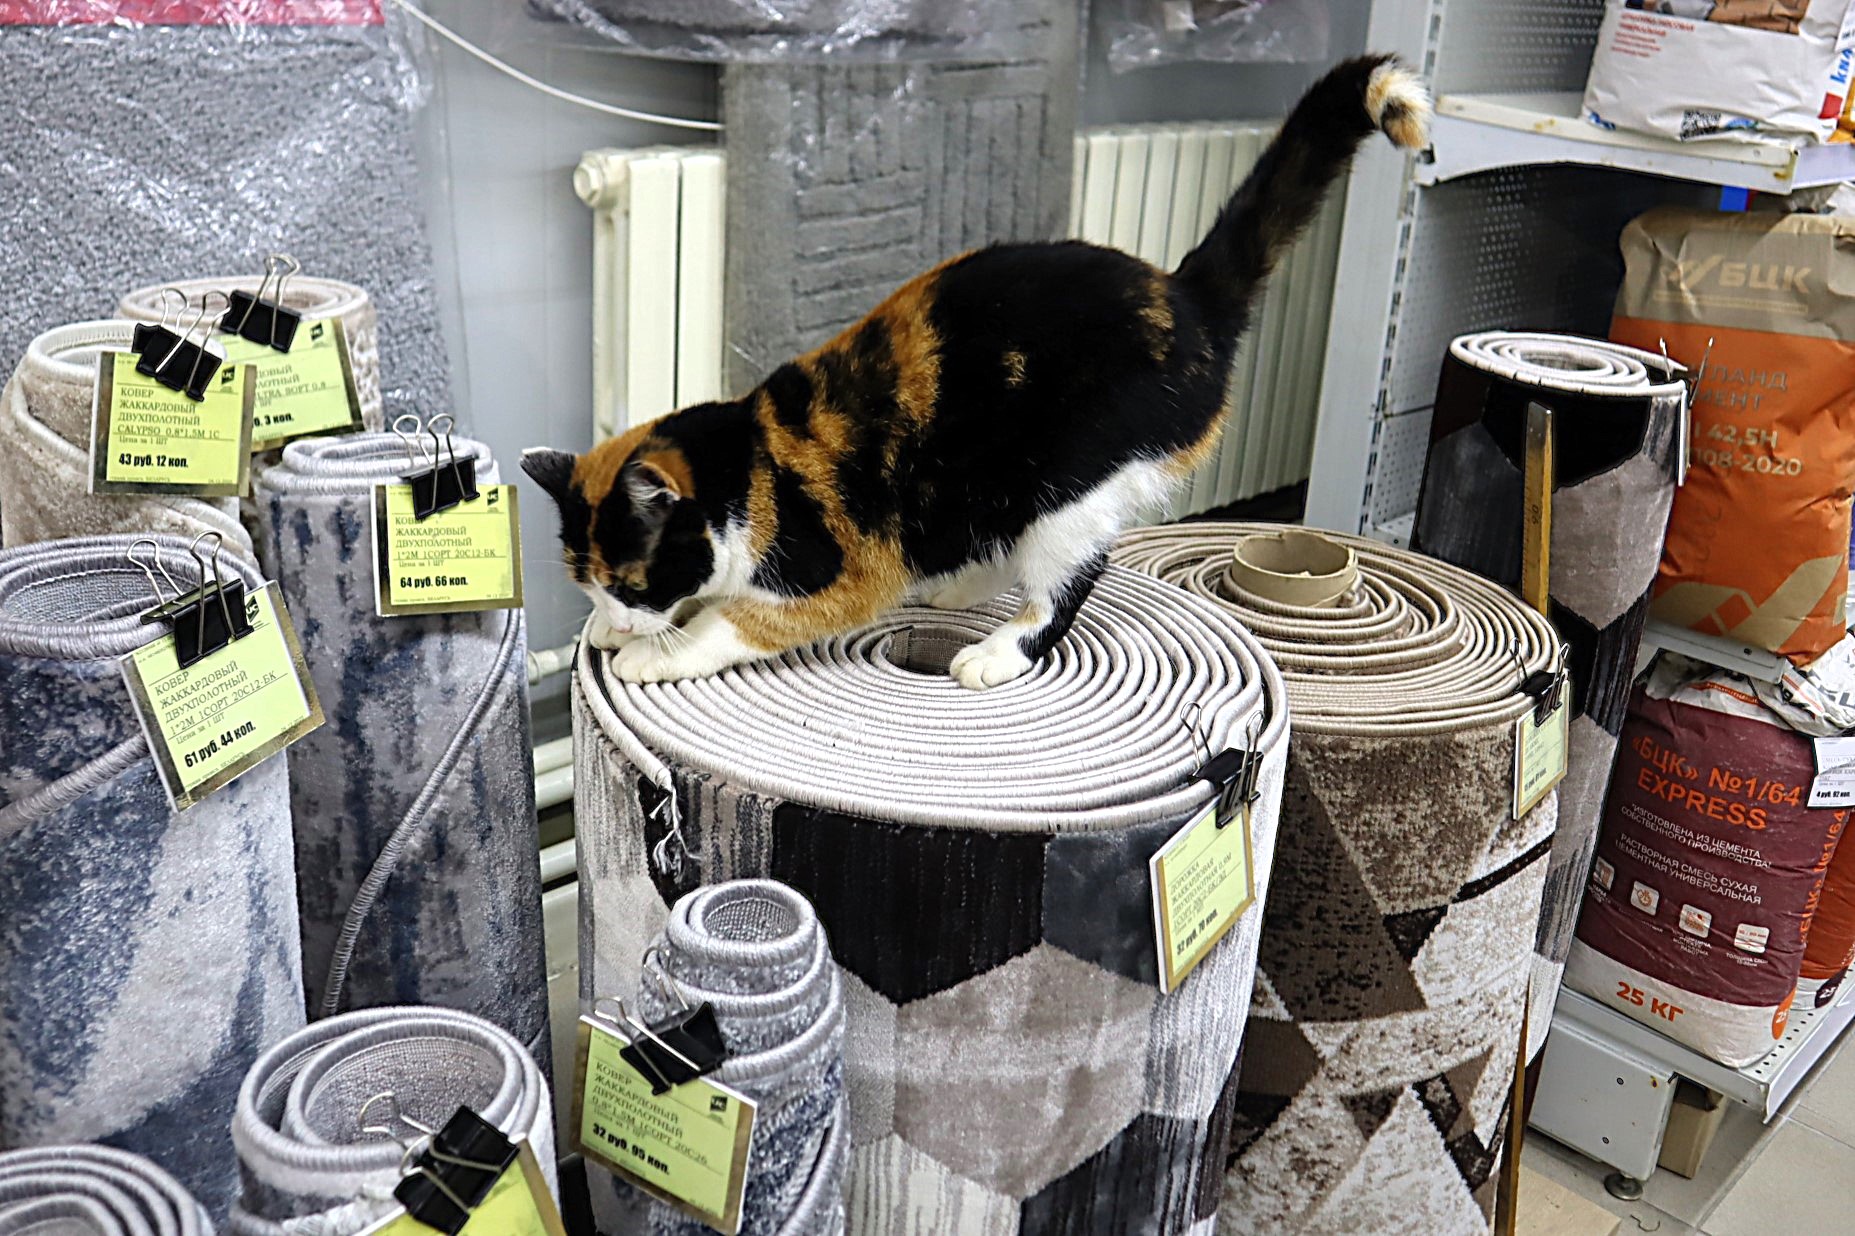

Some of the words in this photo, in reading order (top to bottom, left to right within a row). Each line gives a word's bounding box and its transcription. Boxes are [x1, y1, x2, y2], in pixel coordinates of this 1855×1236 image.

[1718, 261, 1812, 294] БЦК
[1706, 365, 1788, 391] ЛАНД
[119, 399, 196, 413] ЖАККАРДОВЫЙ
[121, 387, 154, 398] КОВЕР
[117, 424, 161, 435] CALYPSO
[118, 412, 201, 425] ДВУХПОЛОТНЫЙ
[264, 414, 271, 425] 3
[273, 413, 295, 424] коп.
[119, 436, 138, 445] Цена
[119, 453, 131, 465] 43
[133, 455, 154, 467] руб.
[157, 455, 167, 467] 12
[168, 457, 188, 468] коп.
[395, 526, 467, 537] ЖАККАРДОВЫЙ
[395, 537, 472, 548] ДВУХПОЛОТНЫЙ
[399, 560, 416, 568] Цена
[423, 550, 450, 559] 1СОРТ
[455, 548, 496, 558] 20С12-БК
[400, 577, 412, 588] 64
[414, 576, 433, 588] руб.
[435, 576, 447, 586] 66
[449, 576, 468, 586] коп.
[154, 671, 189, 696] КОВЕР
[161, 660, 239, 710] ЖАККАРДОВЫЙ
[165, 670, 248, 724] ДВУХПОЛОТНЫЙ
[200, 696, 229, 721] 1СОРТ
[232, 670, 277, 702] 20С12-БК
[176, 730, 197, 745] Цена
[213, 712, 225, 724] ШТ
[184, 751, 199, 768] 61
[198, 739, 221, 762] руб.
[220, 730, 234, 746] 44
[234, 721, 256, 740] коп.
[1632, 735, 1700, 781] «БЦК»
[1708, 767, 1802, 807] №1/64
[1637, 768, 1768, 831] EXPRESS
[1621, 806, 1686, 844] СОБСТВЕННОГО
[1696, 832, 1710, 844] ИЗ
[1712, 838, 1761, 859] ЦЕМЕНТА
[1615, 840, 1668, 873] ЦЕМЕНТНАЯ
[1669, 869, 1762, 905] УНИВЕРСАЛЬНАЯ
[1620, 833, 1679, 870] РАСТВОРНАЯ
[1681, 863, 1718, 883] СМЕСЬ
[1720, 877, 1758, 894] СУХАЯ
[1616, 981, 1645, 1006] 25
[1651, 997, 1684, 1022] КГ
[596, 1062, 632, 1084] КОВЕР
[592, 1085, 683, 1138] ДВУХПОЛОТНЫЙ
[594, 1073, 679, 1123] ЖАККАРДОВЫЙ
[593, 1123, 606, 1139] 32
[607, 1133, 630, 1152] руб.
[631, 1144, 646, 1161] 95
[647, 1156, 670, 1175] коп.
